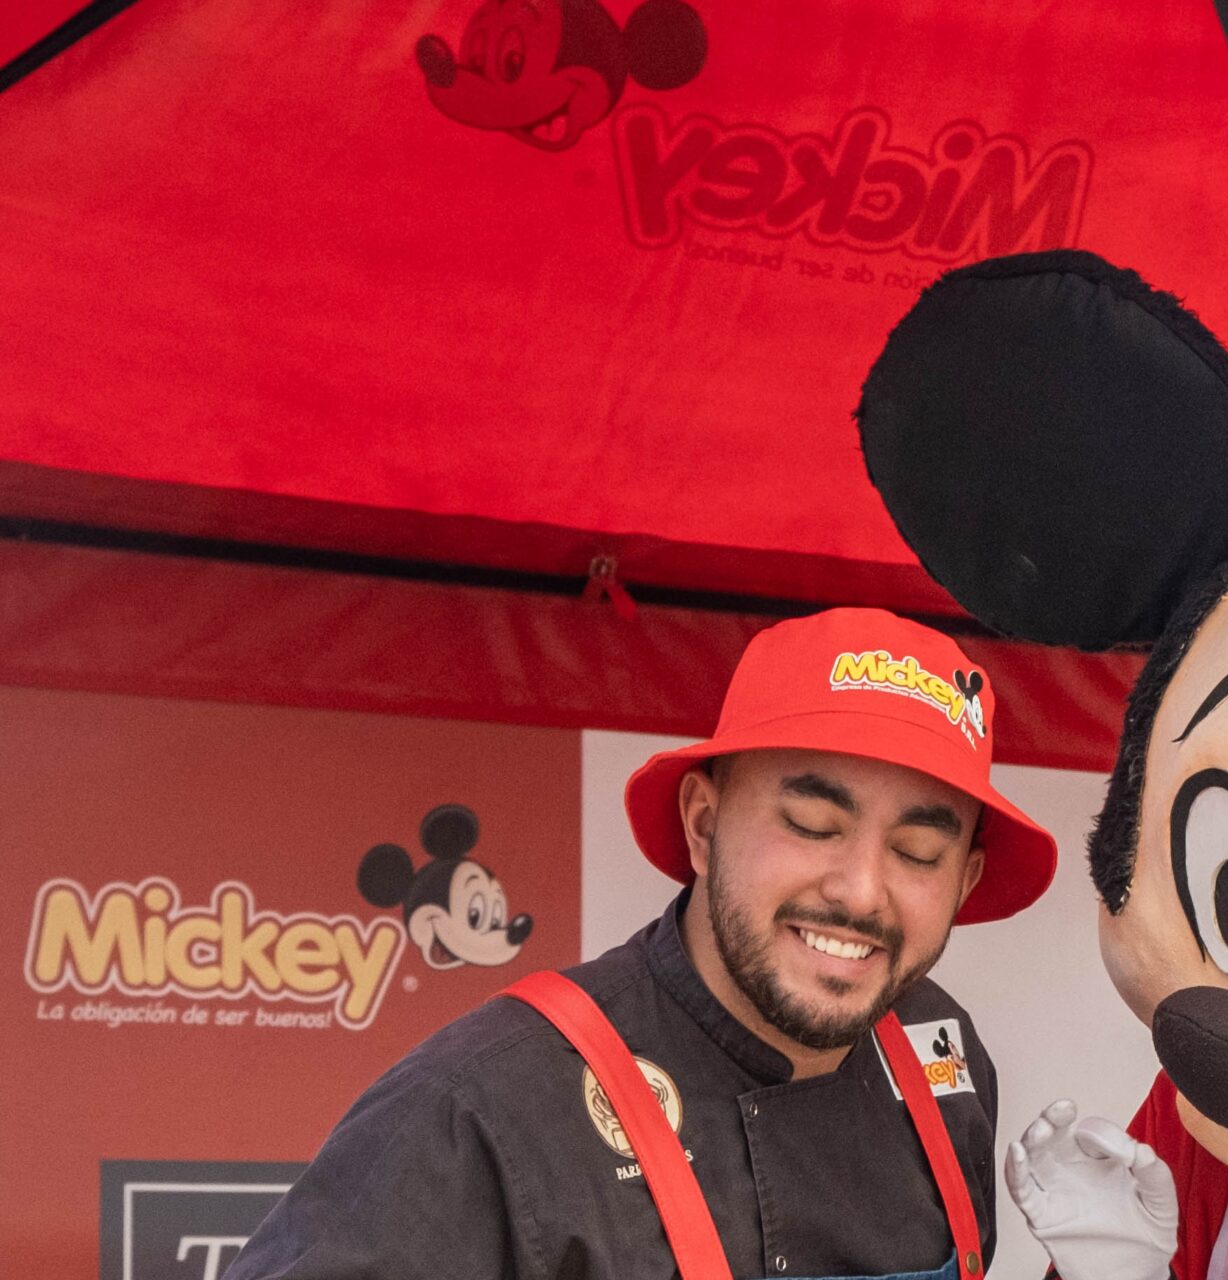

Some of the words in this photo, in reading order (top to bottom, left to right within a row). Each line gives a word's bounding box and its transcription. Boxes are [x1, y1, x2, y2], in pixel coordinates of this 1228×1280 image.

[830, 650, 965, 725] Mickey
[27, 878, 403, 1028] Mickey
[37, 1002, 63, 1020] La
[71, 1002, 176, 1028] obligación
[182, 1004, 208, 1024] de
[215, 1009, 248, 1026] ser
[255, 1009, 332, 1029] buenos!
